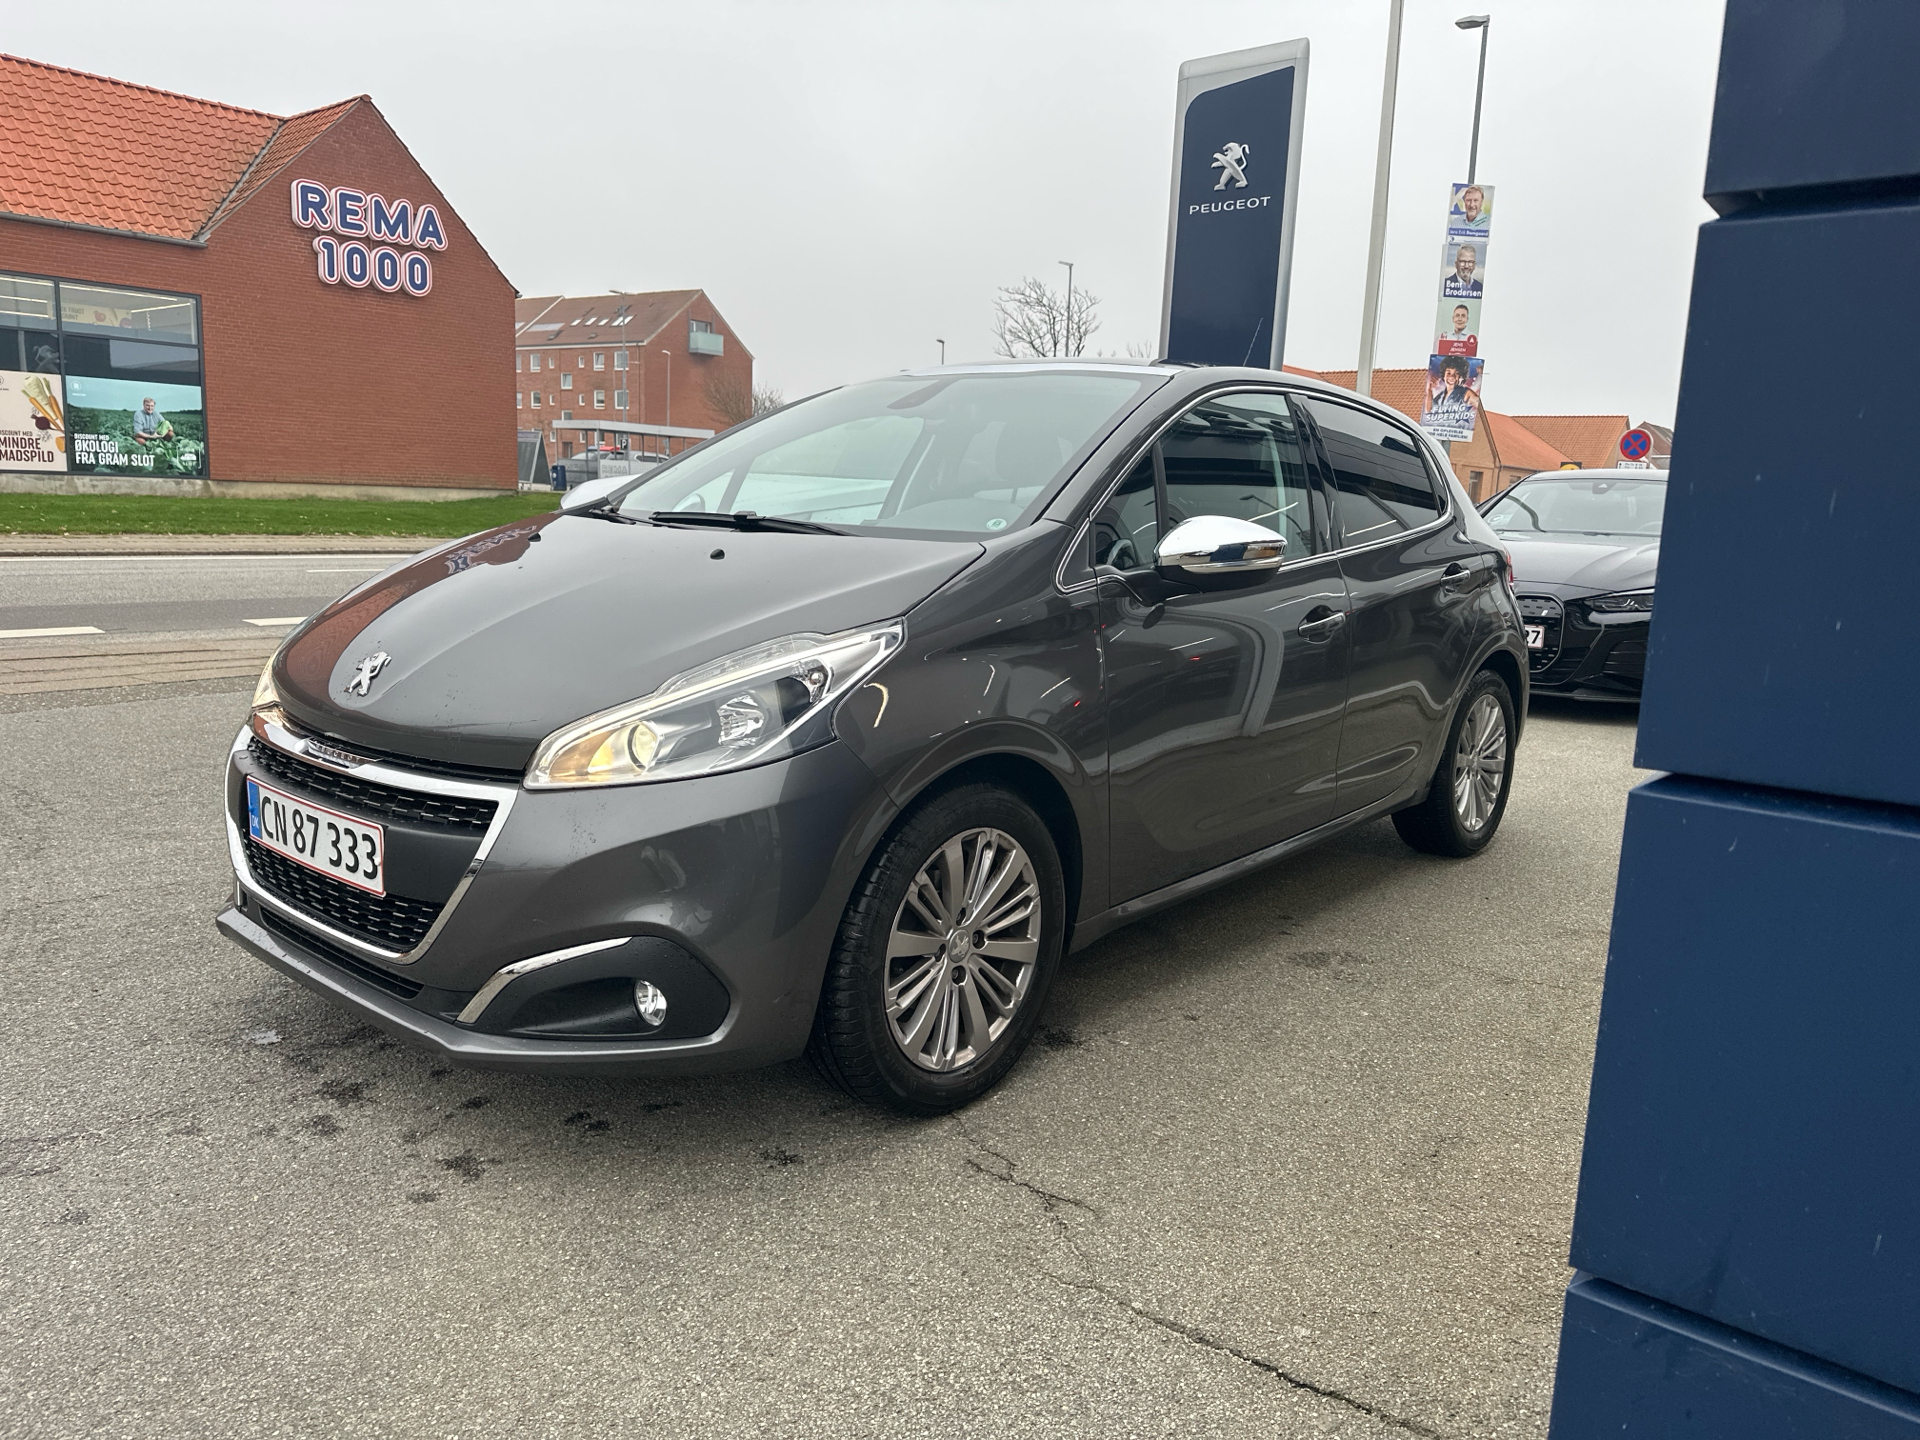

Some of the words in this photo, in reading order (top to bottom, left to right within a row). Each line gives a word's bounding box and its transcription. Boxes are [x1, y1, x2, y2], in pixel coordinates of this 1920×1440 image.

[1189, 196, 1271, 215] PEUGEOT
[292, 180, 447, 250] REMA
[313, 236, 432, 297] 1000
[1446, 280, 1463, 288] Bent
[1445, 288, 1482, 297] Brodersen
[1431, 403, 1466, 414] FLYING
[1425, 411, 1476, 422] SUPERKIDS
[0, 436, 42, 450] MINDRE
[74, 440, 119, 453] ØKOLOGI
[621, 440, 627, 448] P
[0, 449, 55, 463] MADSPILD
[75, 451, 96, 465] FRA
[98, 453, 129, 466] GRAM
[130, 454, 156, 467] SLOT
[251, 815, 260, 829] DK
[261, 795, 288, 846] CN
[291, 808, 319, 858] 87
[327, 822, 378, 880] 333
